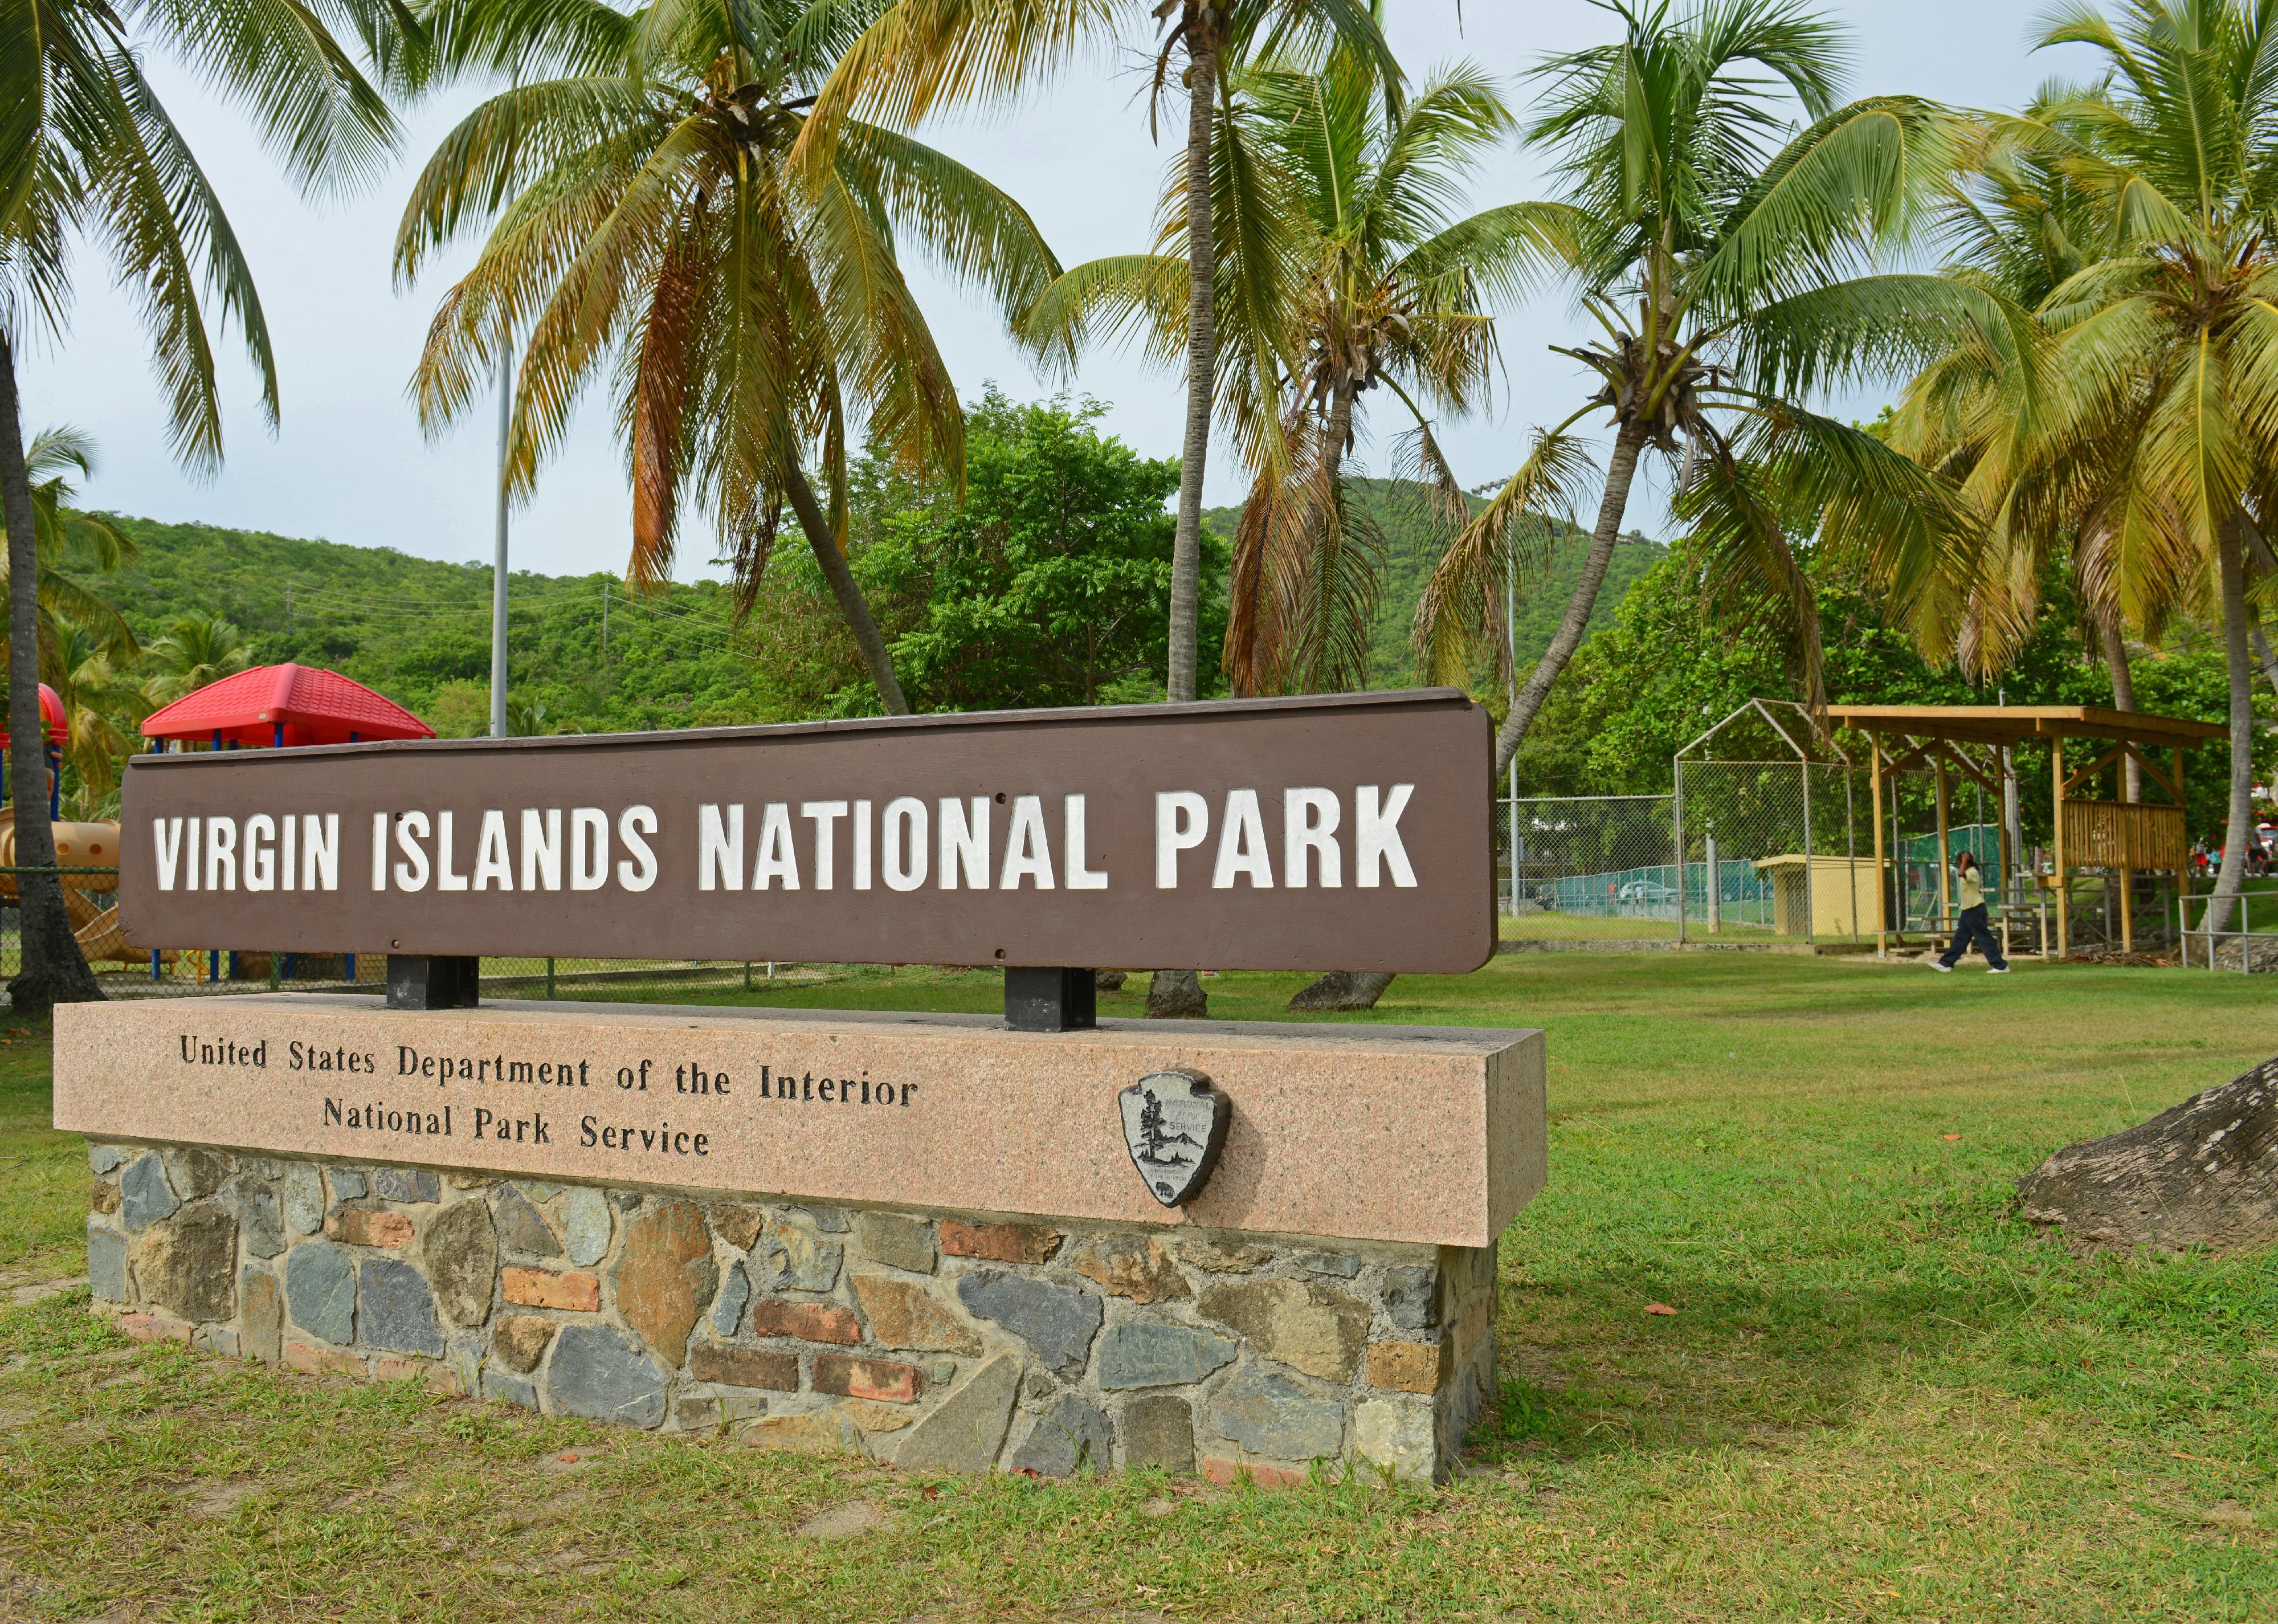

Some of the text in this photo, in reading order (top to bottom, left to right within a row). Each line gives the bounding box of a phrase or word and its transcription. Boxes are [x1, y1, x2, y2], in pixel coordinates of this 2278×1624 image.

[153, 784, 1418, 893] VIRGIN ISLANDS NATIONAL PARK
[180, 1035, 918, 1107] United States Department of the Interior
[323, 1097, 709, 1156] National Park Service
[1166, 1099, 1210, 1109] NATIONAL
[1170, 1121, 1206, 1133] SERVICE
